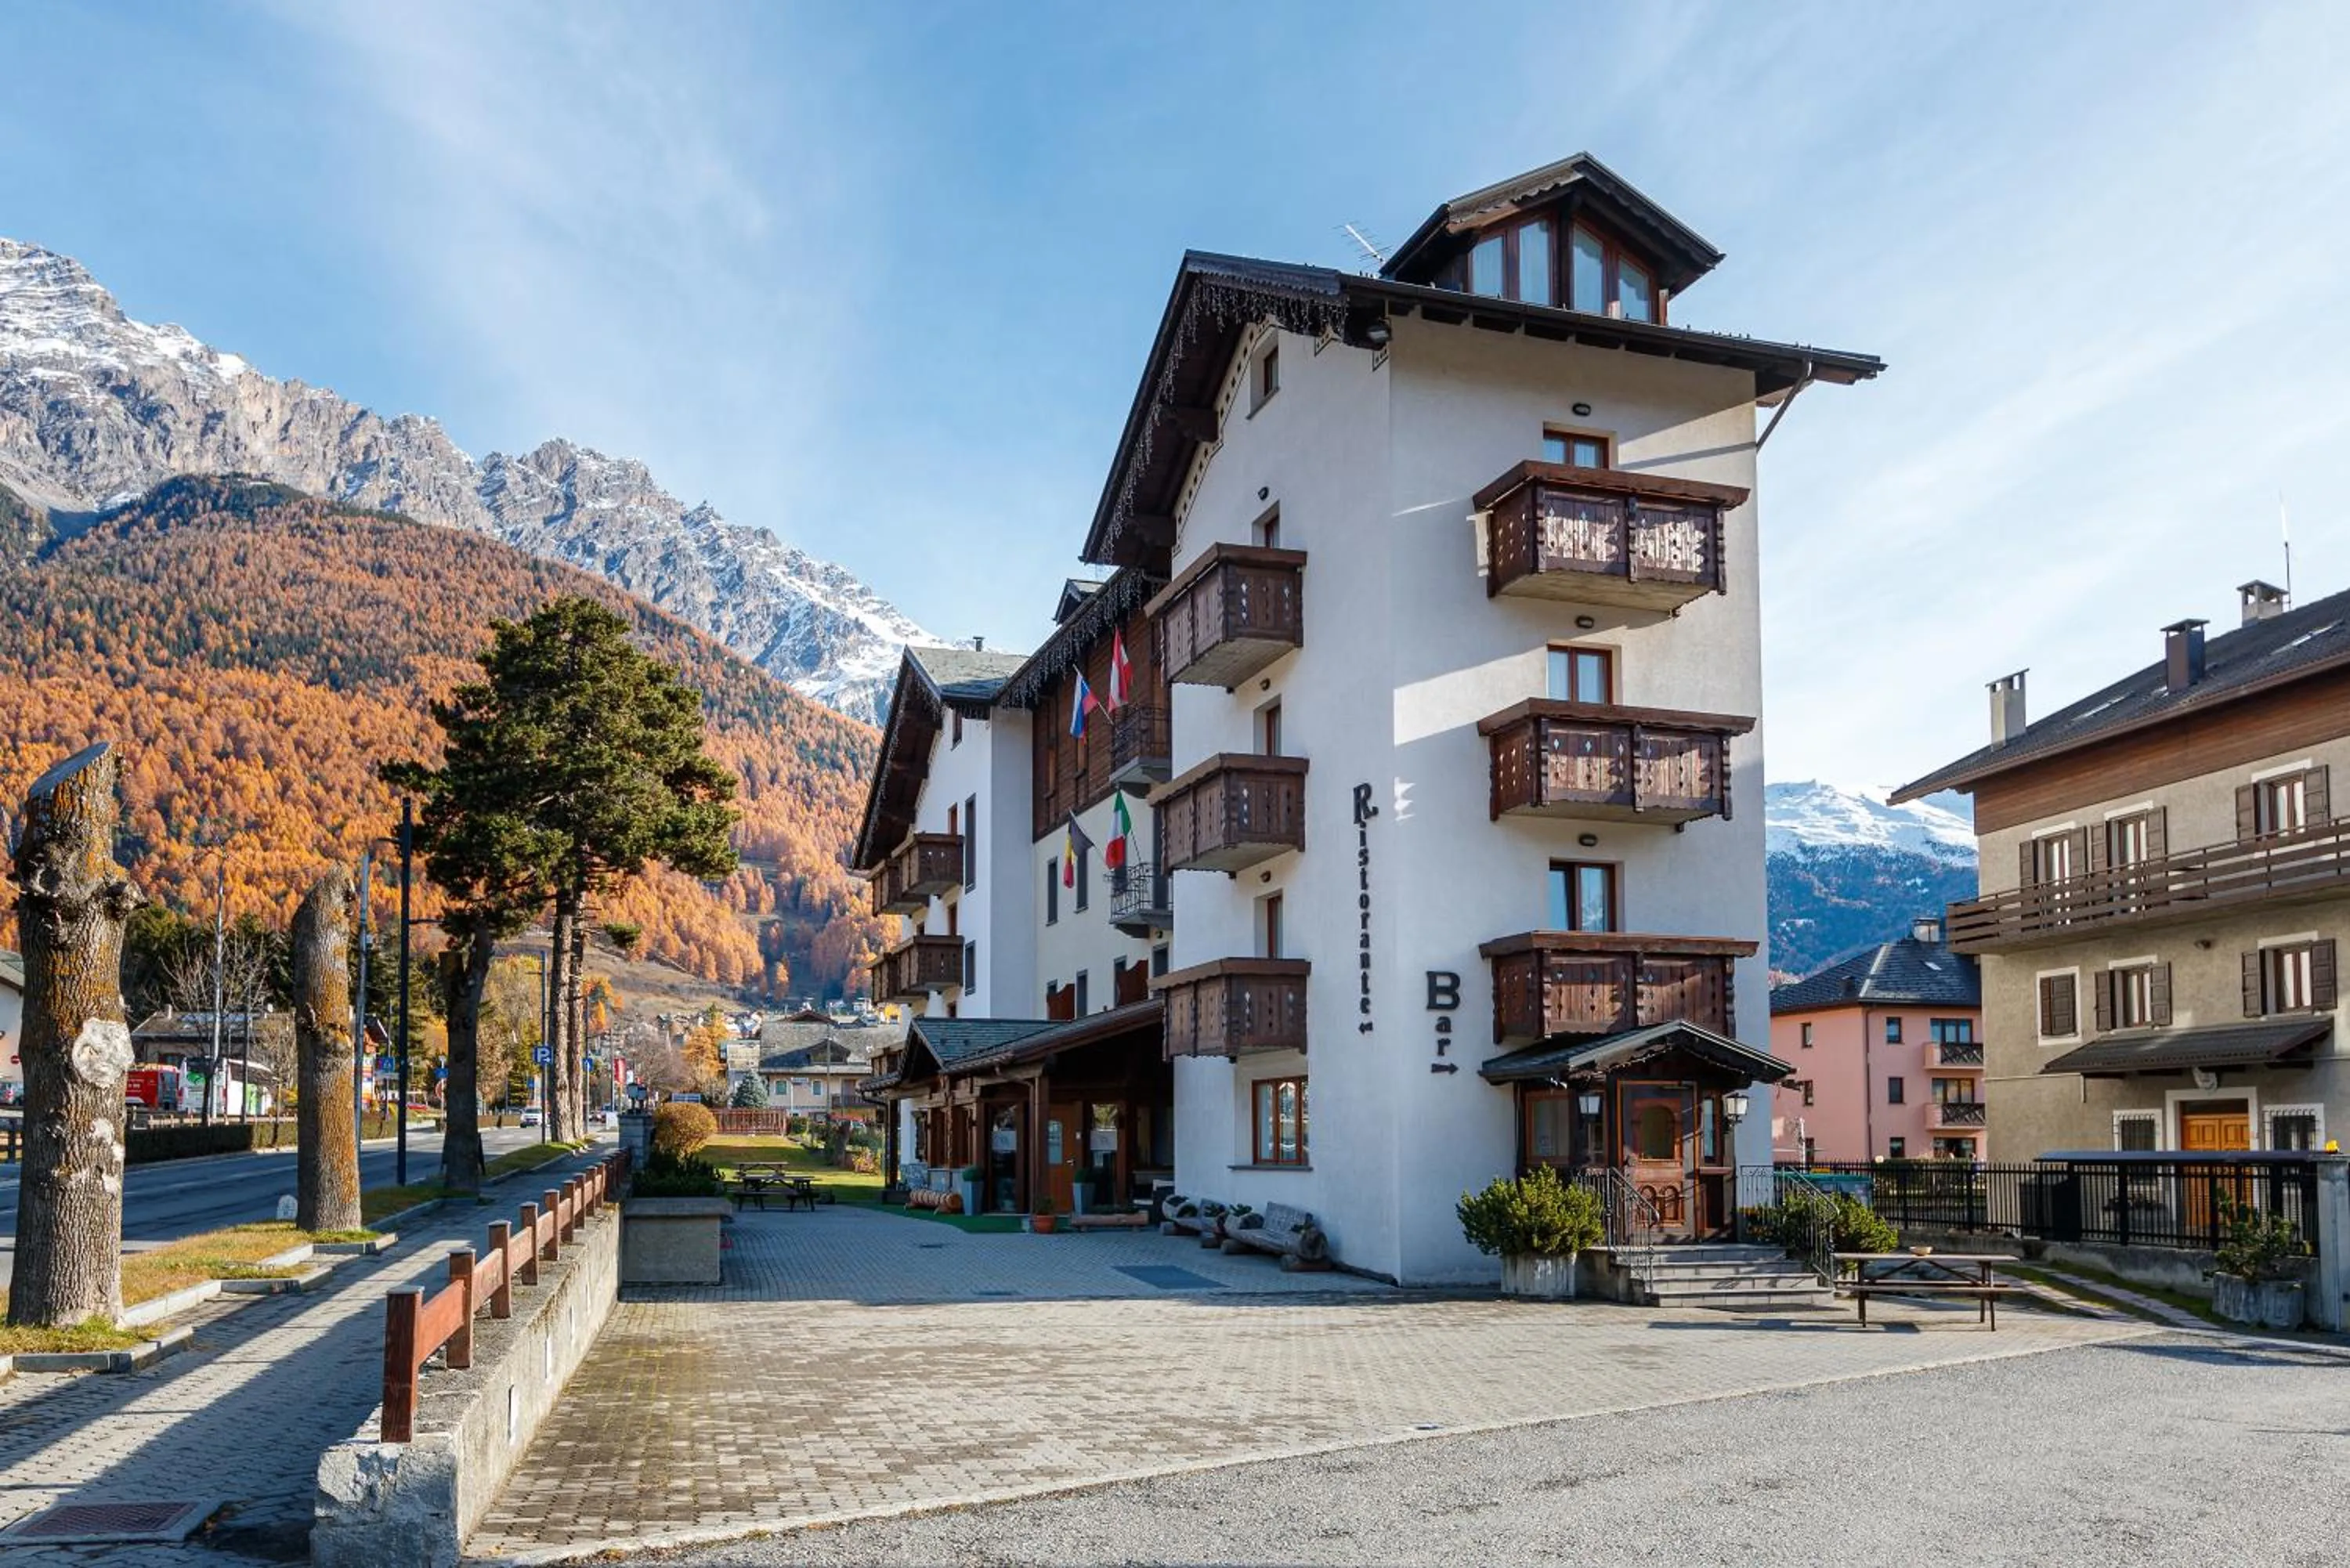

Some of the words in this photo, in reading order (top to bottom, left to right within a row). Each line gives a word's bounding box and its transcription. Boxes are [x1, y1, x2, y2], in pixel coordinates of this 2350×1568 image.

[1354, 783, 1379, 1014] Ristorante
[537, 1047, 550, 1063] P
[1426, 970, 1461, 1056] Bar
